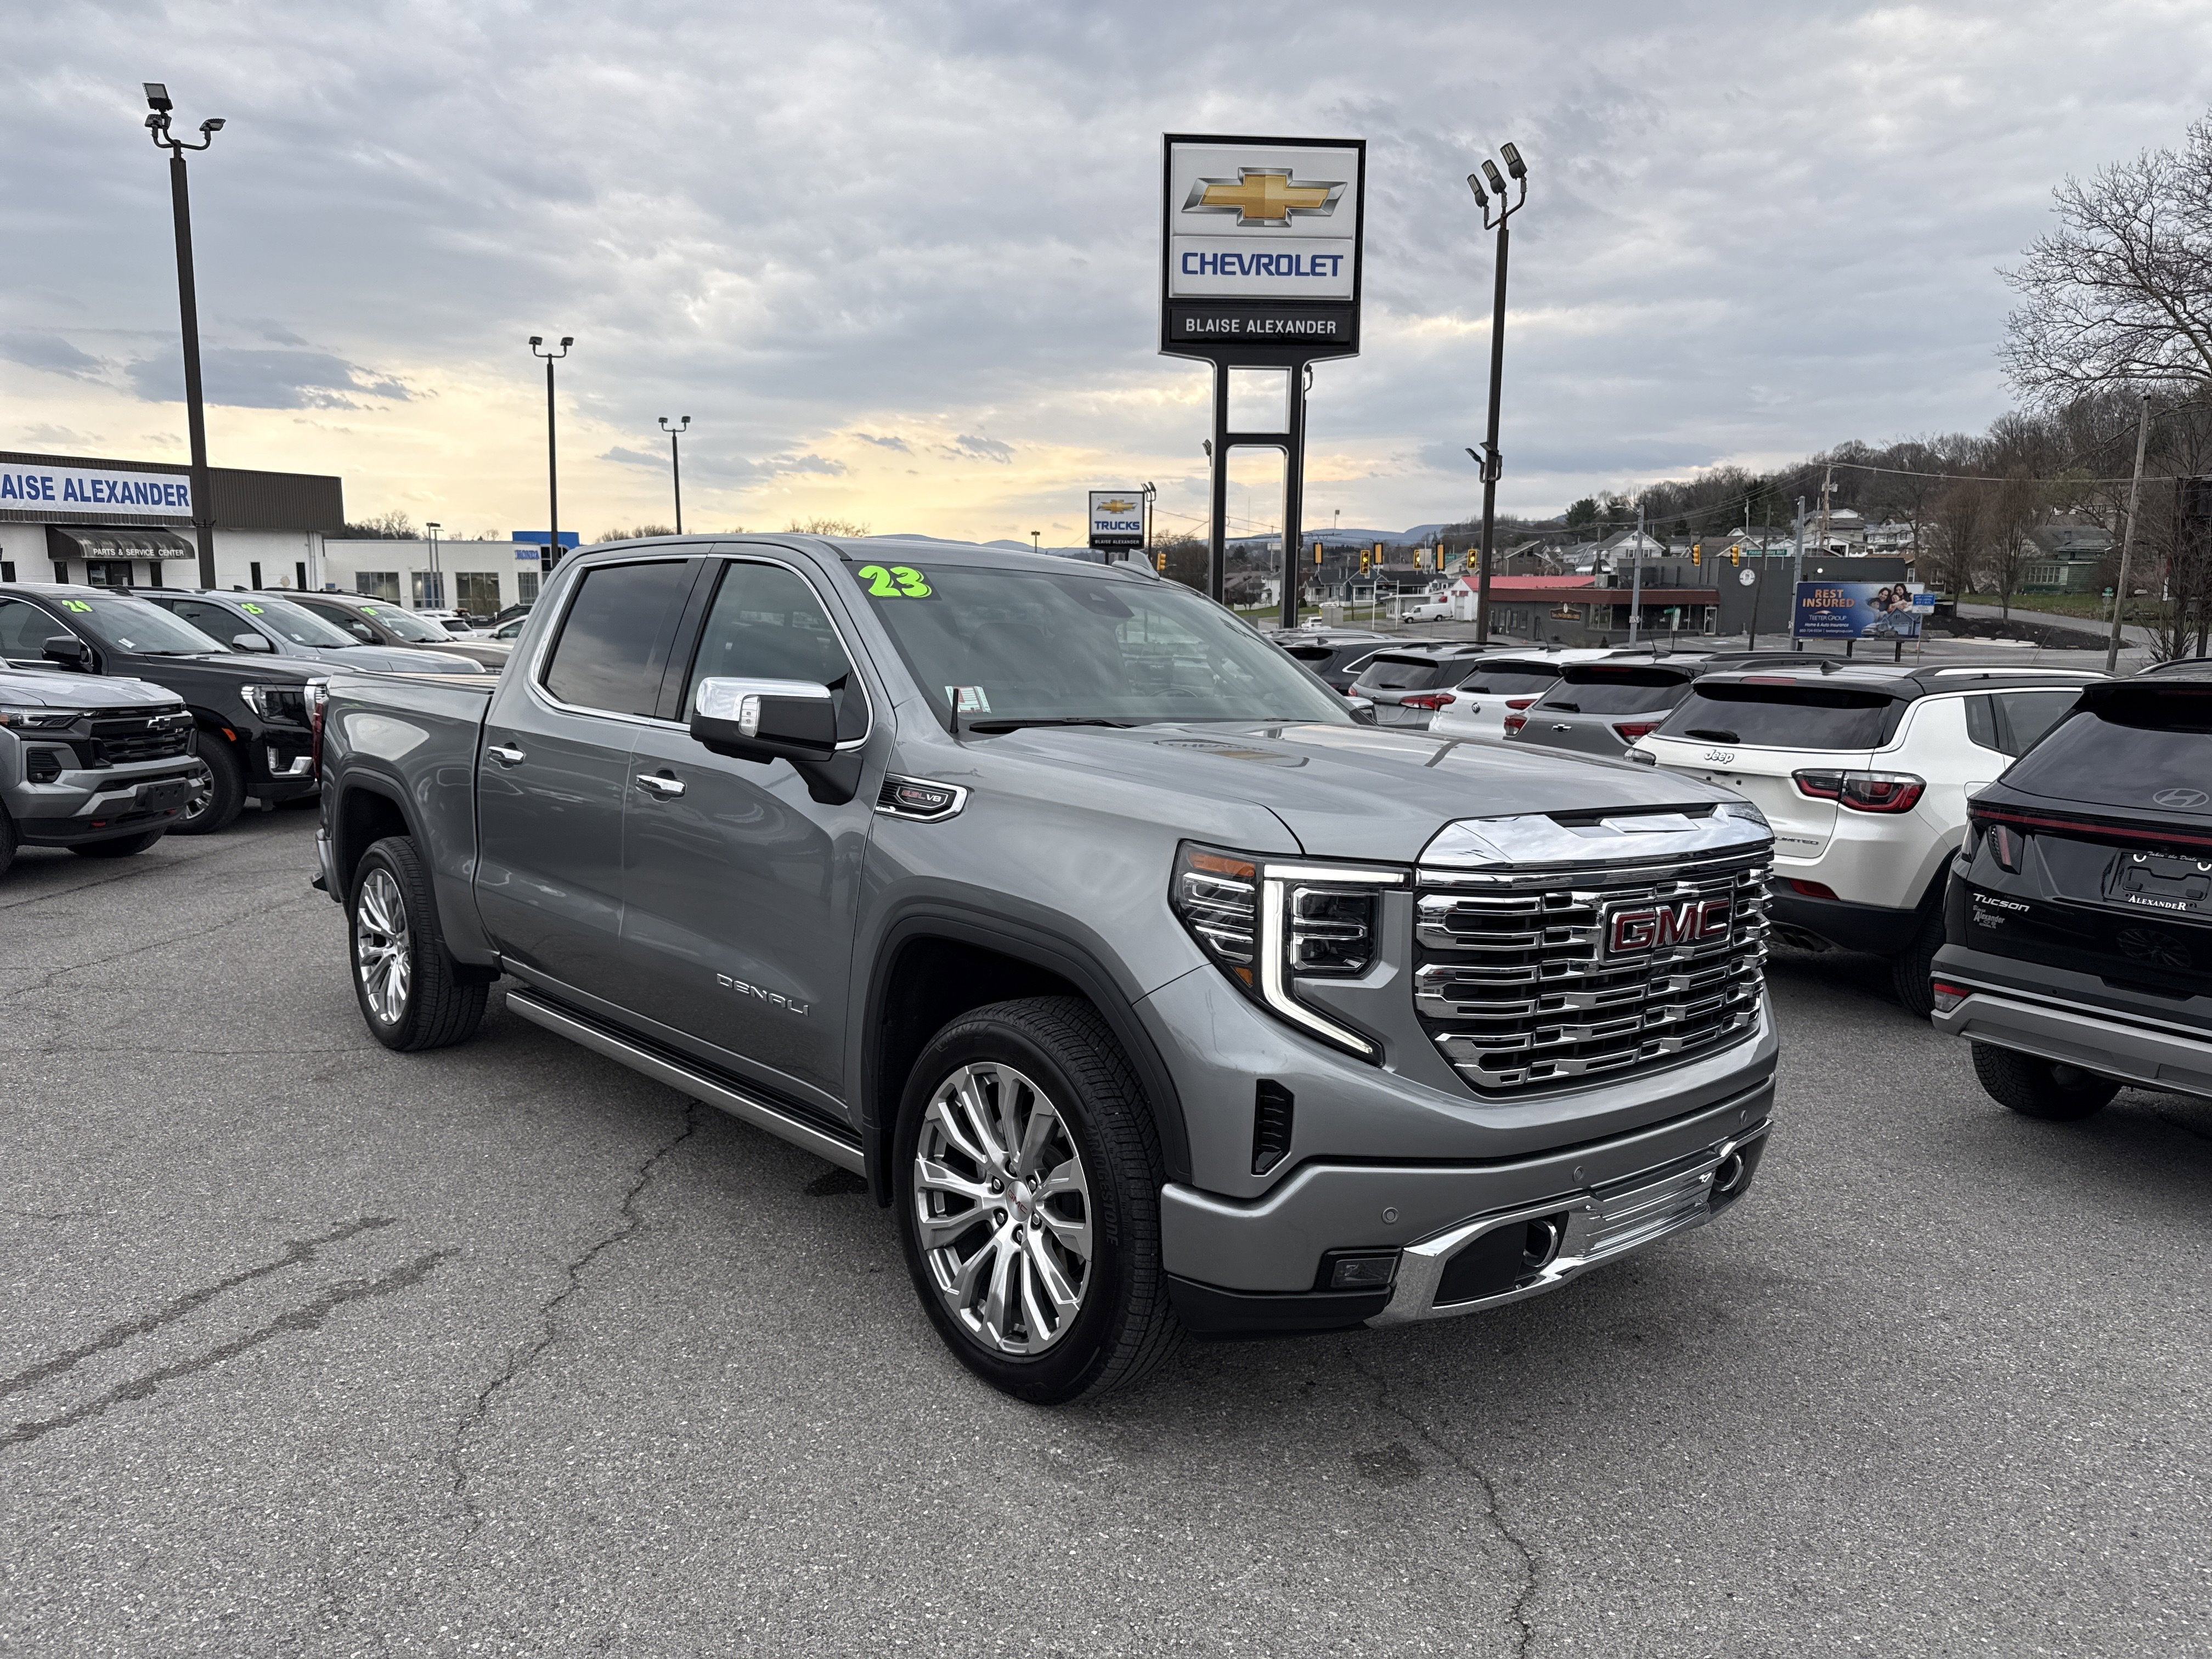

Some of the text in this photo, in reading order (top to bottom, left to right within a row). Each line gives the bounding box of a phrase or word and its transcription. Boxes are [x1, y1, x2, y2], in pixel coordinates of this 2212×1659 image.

[1182, 252, 1344, 276] CHEVROLET
[1186, 319, 1336, 334] BLAISE ALEXANDER
[63, 478, 190, 507] ALEXANDER
[1094, 521, 1140, 531] TRUCKS
[859, 565, 932, 597] 23
[1802, 597, 1855, 608] INSURED
[1815, 589, 1844, 599] REST
[61, 600, 93, 613] 24
[1705, 749, 1735, 764] Jeep
[1973, 893, 2030, 912] TUCSON
[2128, 894, 2186, 911] ALEXANDER
[1610, 898, 1729, 953] GMC
[1973, 911, 2006, 924] Alexander
[716, 973, 809, 1017] DENALI
[1008, 1188, 1028, 1215] GMC
